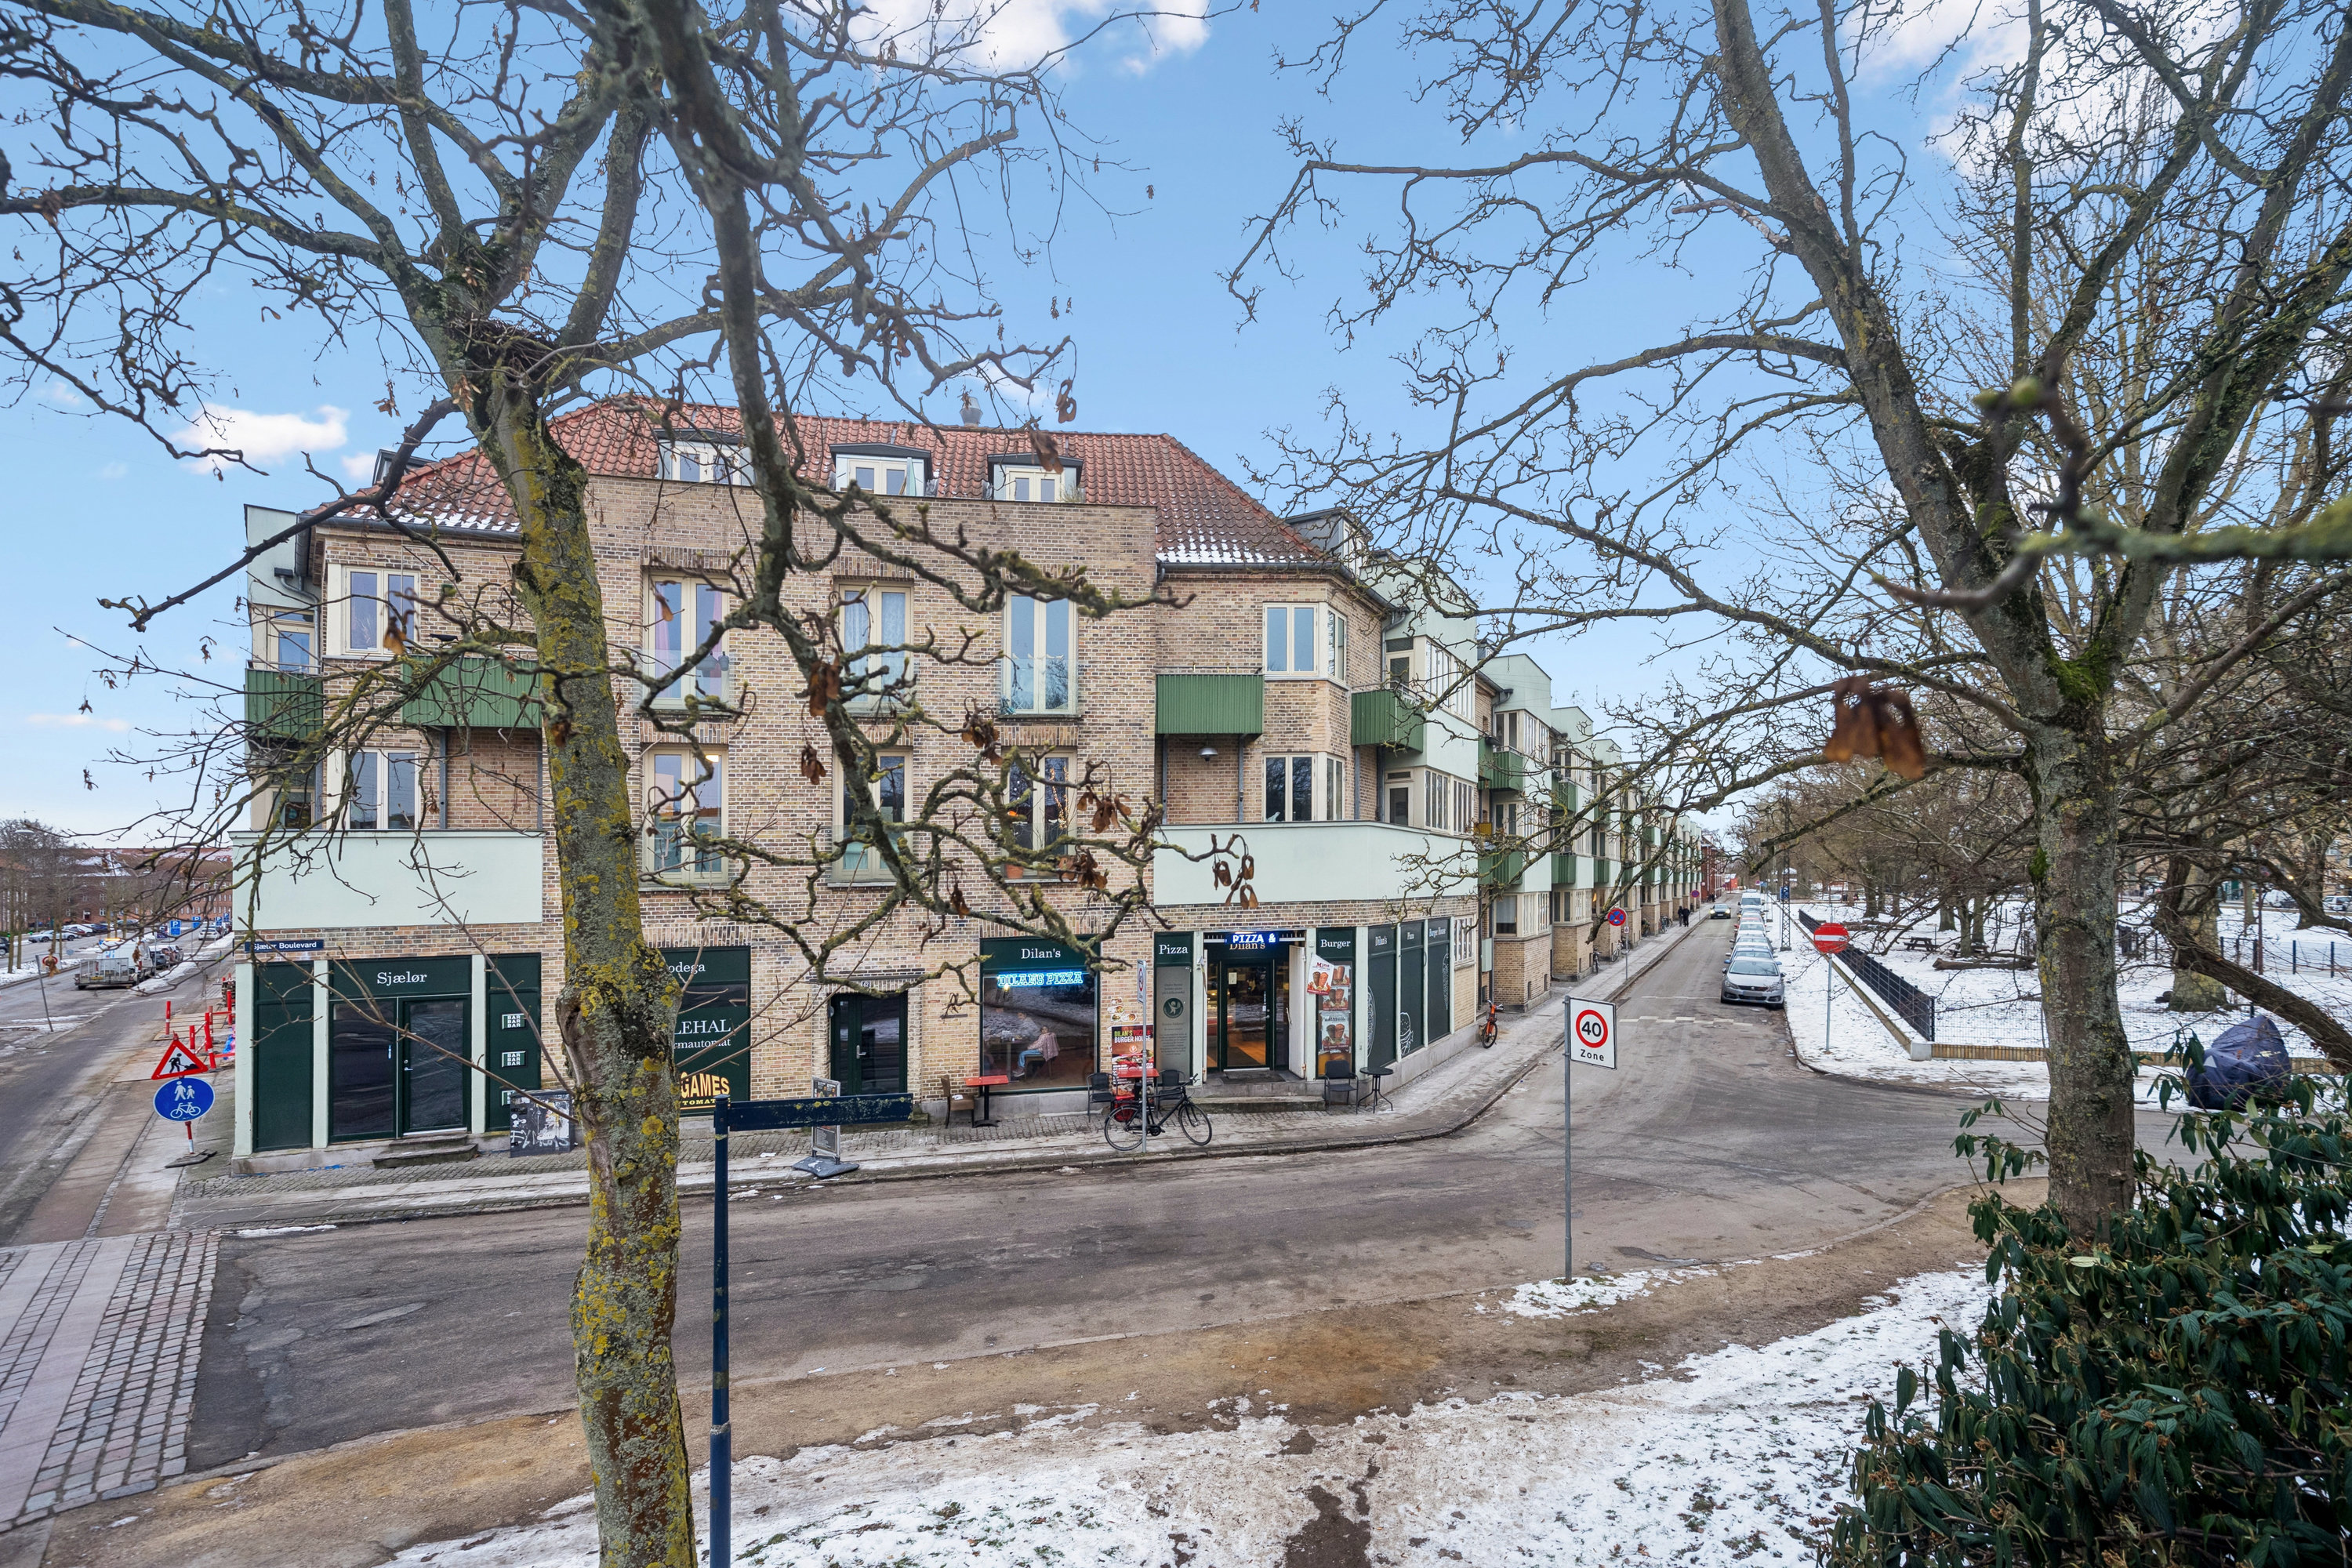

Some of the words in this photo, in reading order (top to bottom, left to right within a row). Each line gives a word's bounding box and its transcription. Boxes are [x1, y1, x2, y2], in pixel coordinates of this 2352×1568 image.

[1232, 934, 1264, 943] PIZZA
[1268, 932, 1276, 943] &
[1320, 938, 1351, 949] Burger
[1375, 935, 1388, 946] Dilan's
[1021, 948, 1062, 959] Dilan's
[1158, 944, 1189, 955] Pizza
[668, 961, 706, 975] odega
[377, 971, 427, 986] Sjælør
[1046, 971, 1083, 985] PIZZA
[1581, 1021, 1602, 1037] 40
[1581, 1049, 1605, 1061] Zone
[681, 1071, 731, 1099] GAMES
